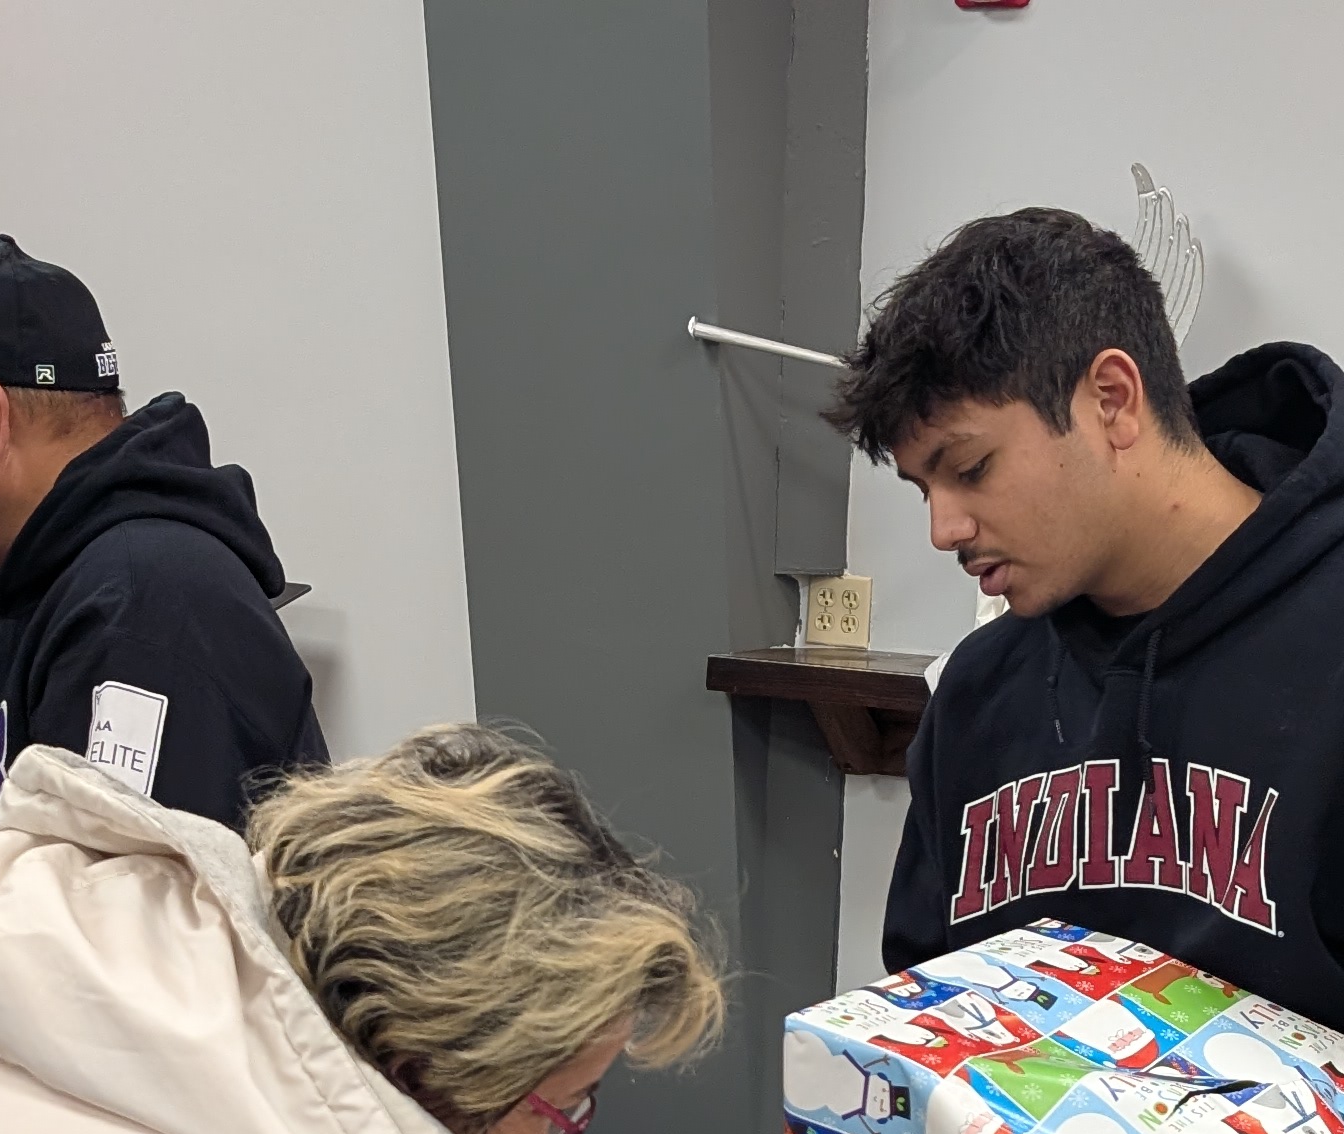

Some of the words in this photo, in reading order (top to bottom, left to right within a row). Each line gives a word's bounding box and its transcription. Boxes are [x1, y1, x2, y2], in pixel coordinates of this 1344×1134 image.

[90, 741, 146, 773] ELITE
[950, 758, 1279, 935] INDIANA
[1239, 1003, 1284, 1030] OLLY
